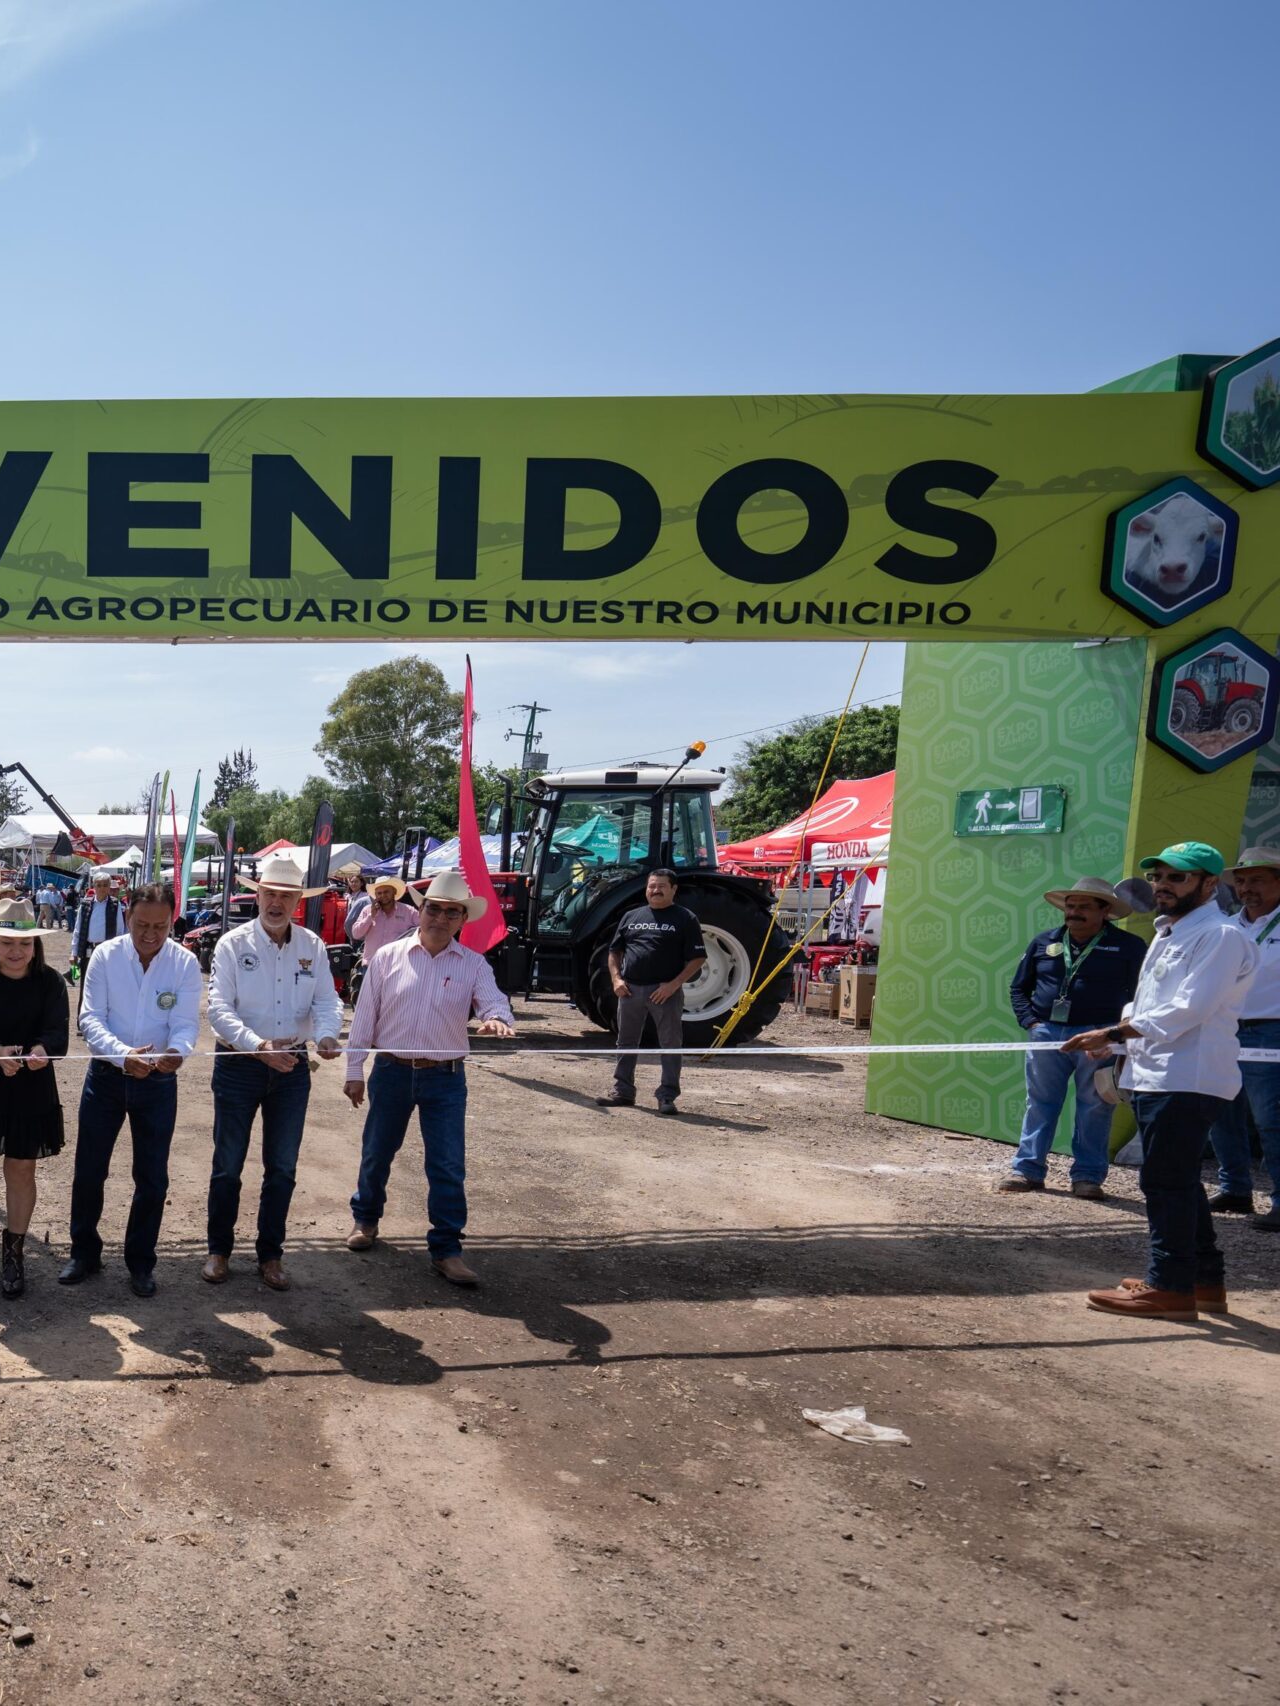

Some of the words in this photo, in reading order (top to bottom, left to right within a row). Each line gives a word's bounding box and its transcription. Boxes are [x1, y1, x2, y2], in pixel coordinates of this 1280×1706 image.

[26, 597, 412, 623] AGROPECUARIO
[429, 598, 486, 623] DE
[506, 599, 720, 624] NUESTRO
[736, 600, 972, 626] MUNICIPIO
[1029, 645, 1073, 666] EXPO
[962, 667, 1000, 687] EXPO
[1069, 698, 1115, 720] EXPO
[998, 719, 1038, 737] EXPO
[932, 738, 970, 757] EXPO
[904, 804, 939, 822] EXPO
[826, 842, 871, 860] HONDA
[1073, 832, 1119, 853] EXPO
[1002, 844, 1040, 861] EXPO
[938, 857, 974, 873] EXPO
[628, 922, 675, 932] CODELBA
[908, 922, 943, 936] EXPO
[969, 914, 1008, 930] EXPO
[883, 981, 916, 993] EXPO
[942, 978, 978, 990] EXPO
[885, 1096, 918, 1107] EXPO
[943, 1098, 980, 1110] EXPO
